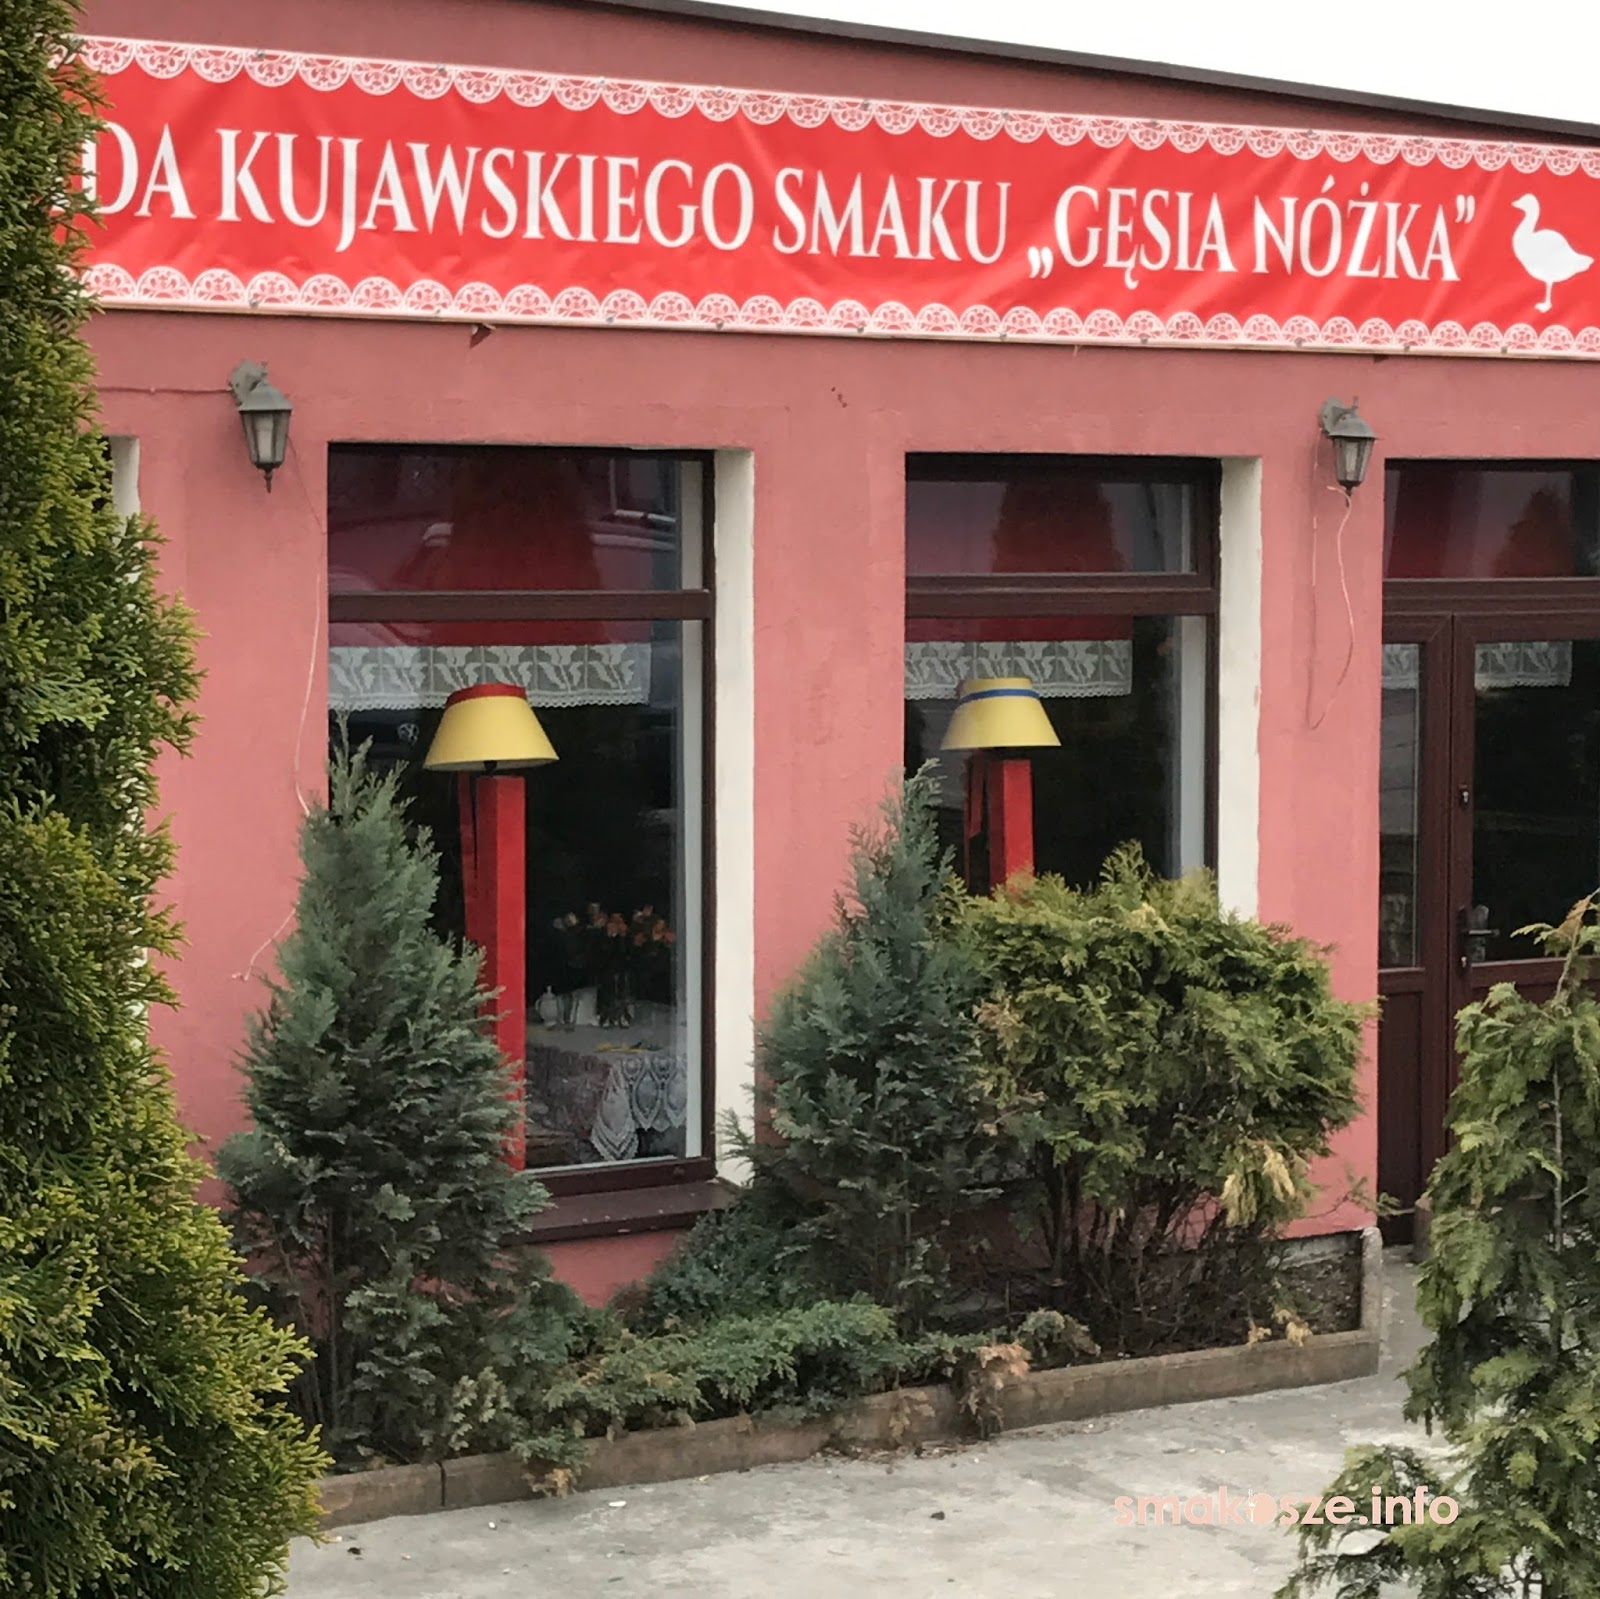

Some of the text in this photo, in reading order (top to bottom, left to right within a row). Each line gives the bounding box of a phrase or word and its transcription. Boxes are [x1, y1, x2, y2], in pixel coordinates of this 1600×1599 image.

[52, 120, 1476, 290] DA KUJAWSKIEGO SMAKU „GĘSIA NÓŻKA”
